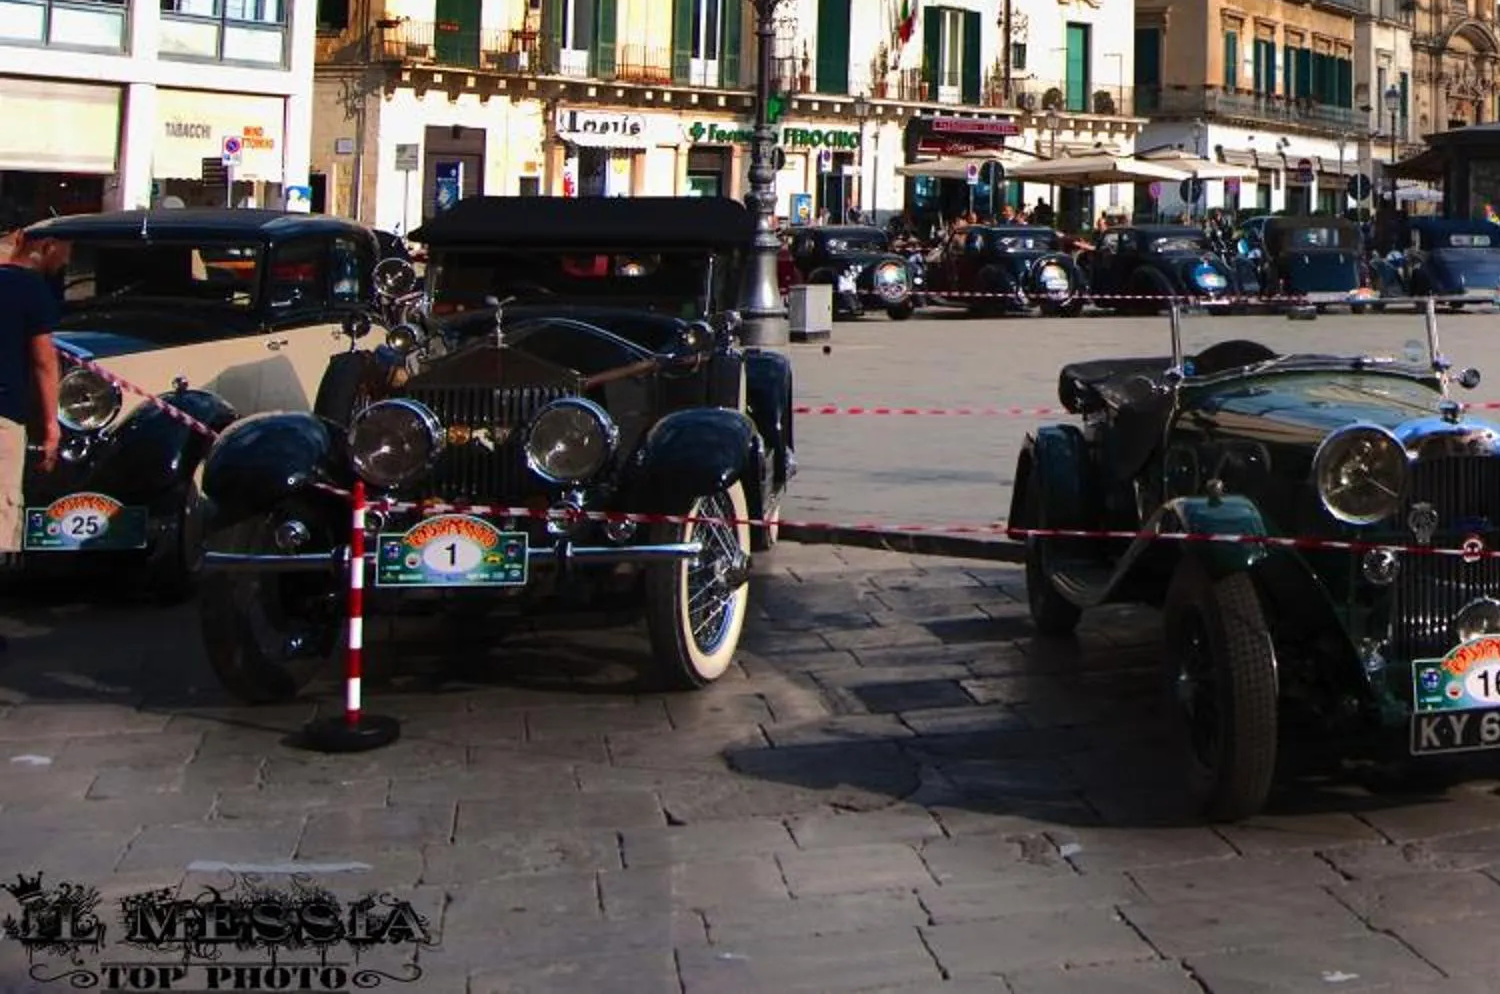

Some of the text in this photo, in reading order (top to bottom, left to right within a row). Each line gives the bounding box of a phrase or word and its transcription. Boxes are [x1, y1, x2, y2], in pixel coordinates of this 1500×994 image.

[165, 122, 211, 139] TABACCHI
[71, 515, 99, 535] 25
[445, 543, 456, 566] 1
[1420, 713, 1470, 748] KY
